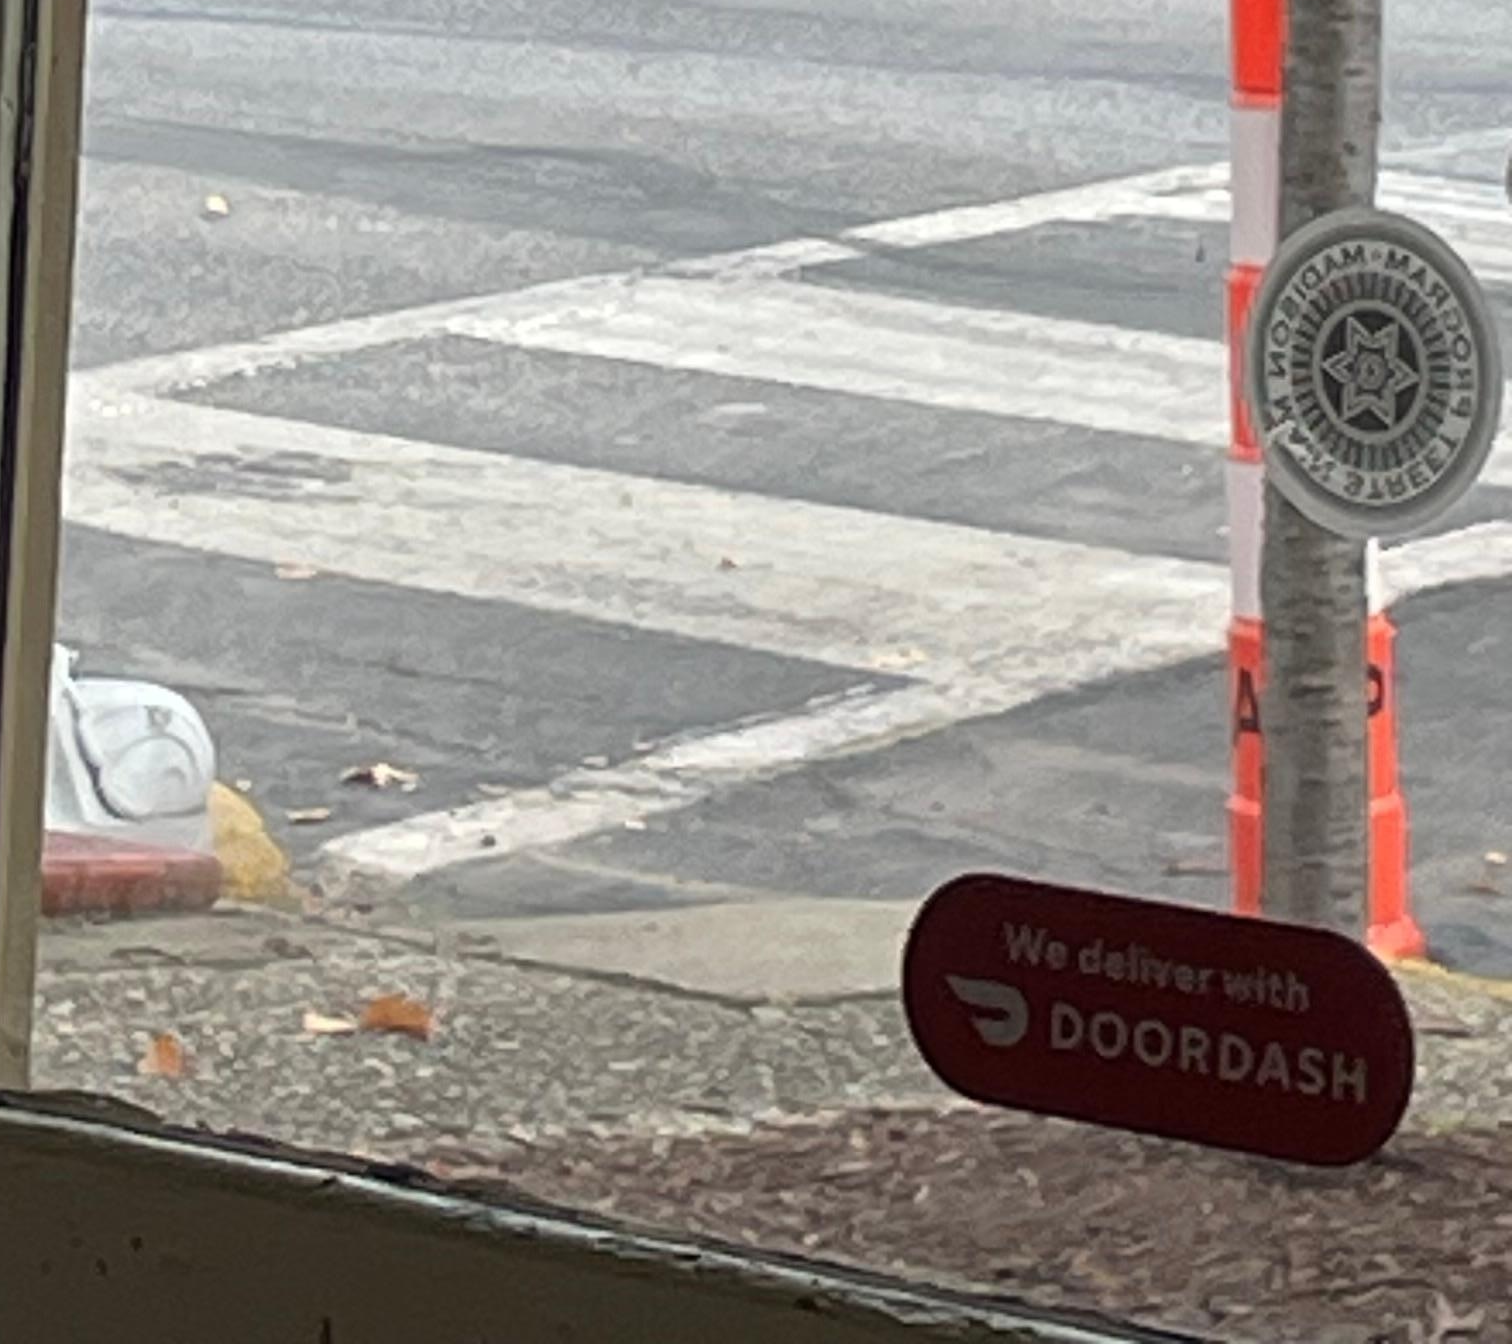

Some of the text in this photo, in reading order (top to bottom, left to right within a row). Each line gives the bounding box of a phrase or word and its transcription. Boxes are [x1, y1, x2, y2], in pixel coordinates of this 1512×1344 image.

[1002, 922, 1311, 1013] We deliver with
[1049, 1003, 1367, 1104] DOORDASH
